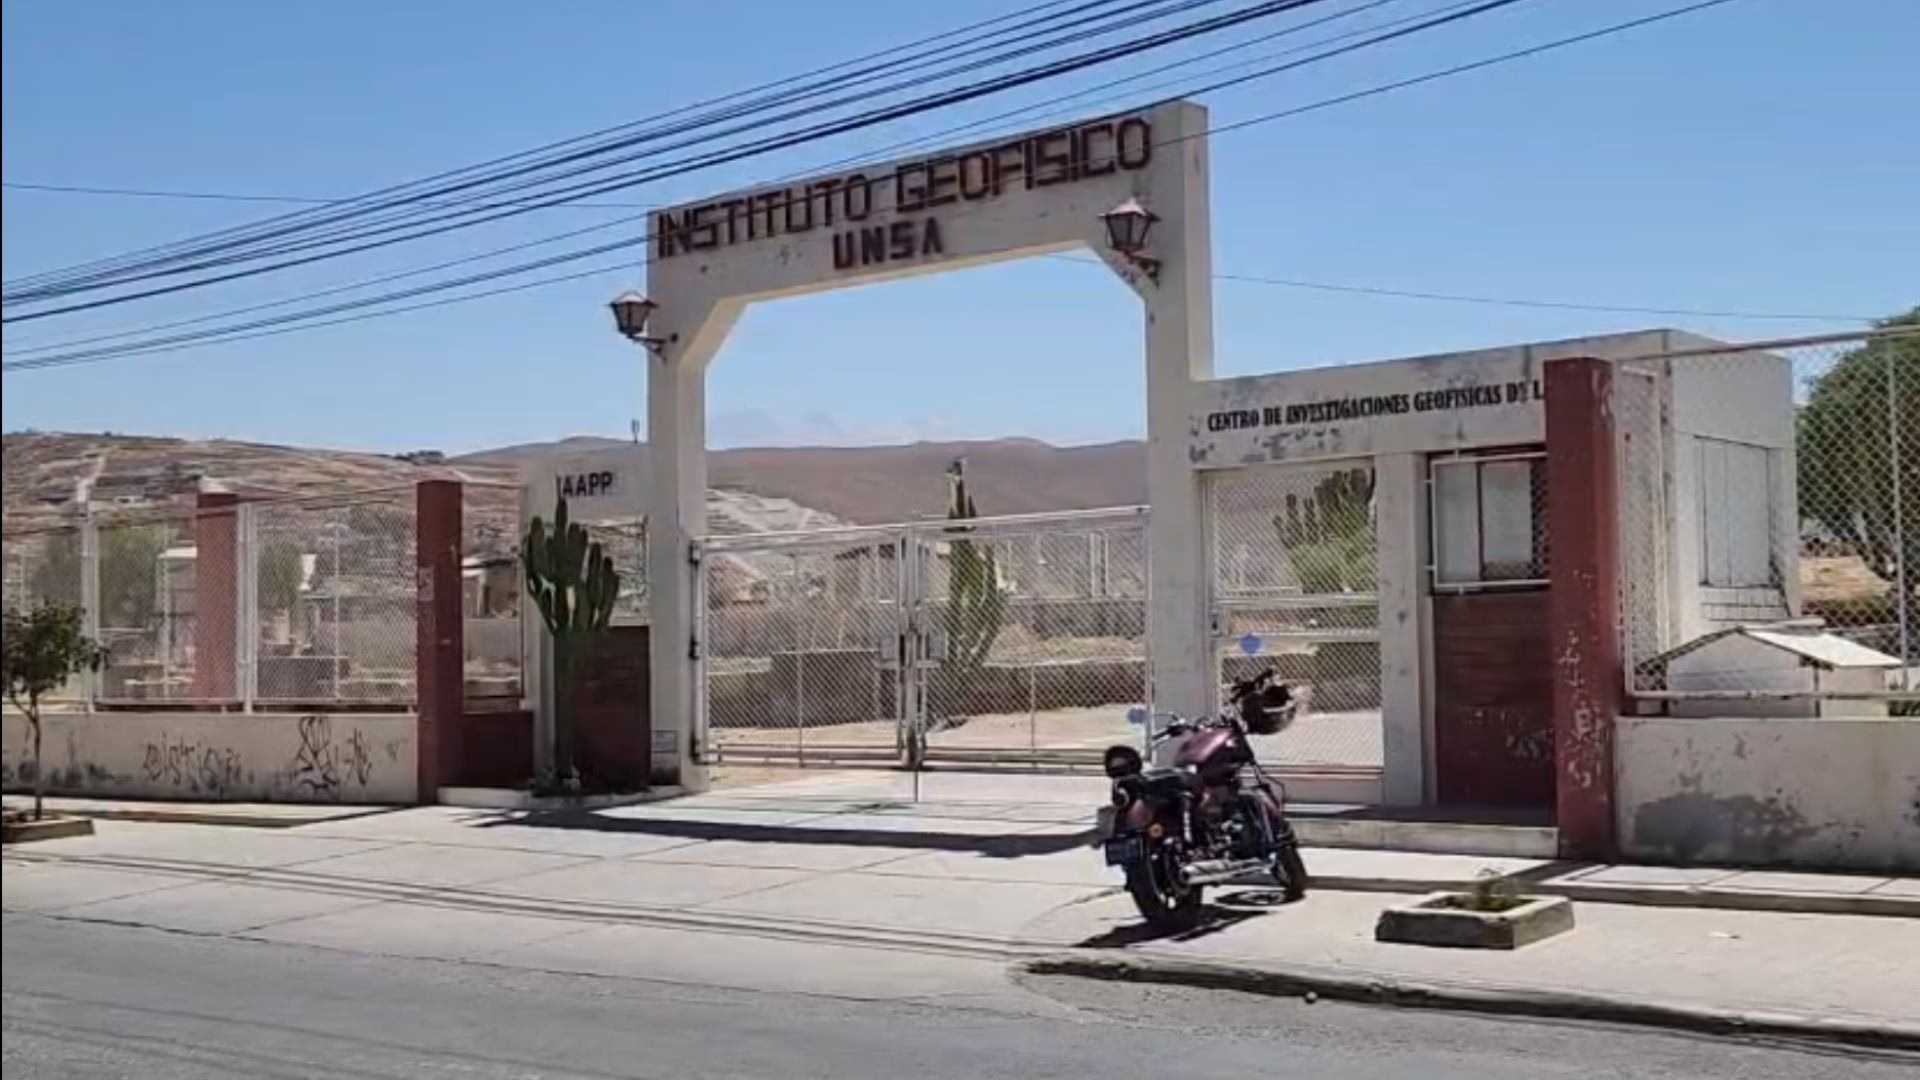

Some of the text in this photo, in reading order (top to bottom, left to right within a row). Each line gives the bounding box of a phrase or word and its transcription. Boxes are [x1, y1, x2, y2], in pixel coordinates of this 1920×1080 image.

[657, 117, 1152, 260] INSTITUTO GEOFISICO
[832, 216, 944, 270] UNSA
[1207, 409, 1260, 432] CENTRO
[1263, 407, 1282, 427] DE
[1285, 394, 1410, 424] INVESTIGACIONES
